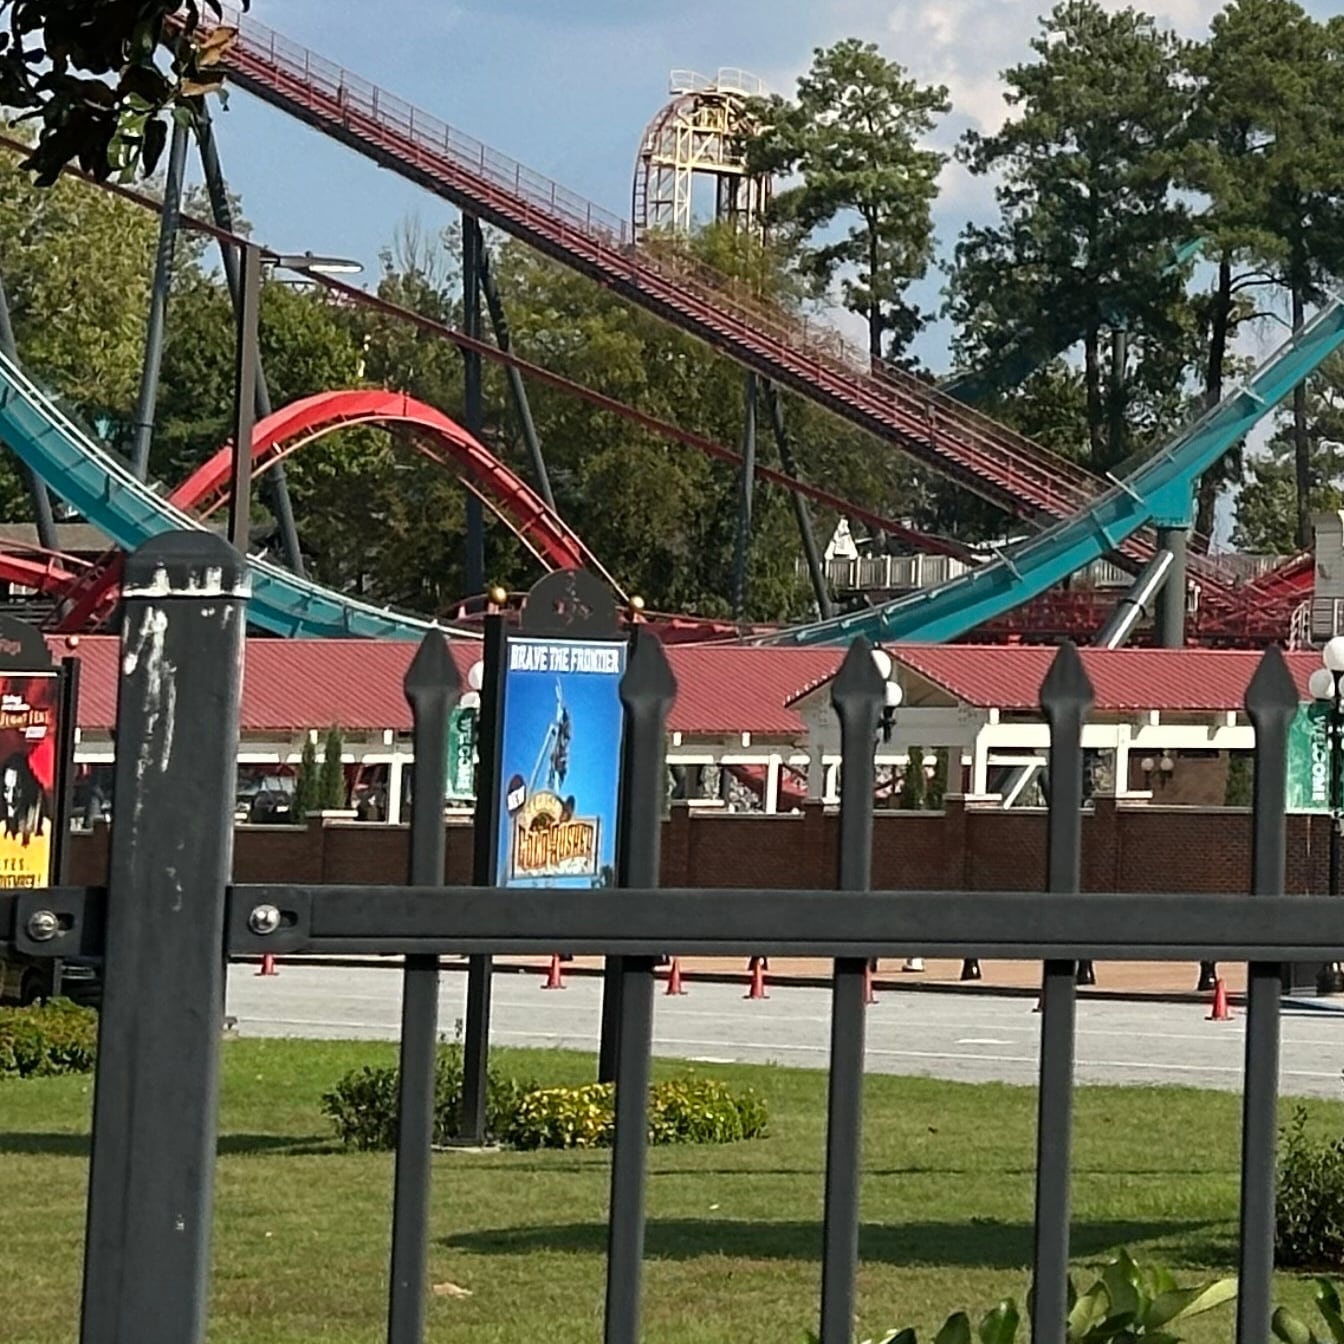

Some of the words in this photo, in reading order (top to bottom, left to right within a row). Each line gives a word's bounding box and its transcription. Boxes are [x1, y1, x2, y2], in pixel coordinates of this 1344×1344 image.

[510, 644, 548, 671] BRAVE
[549, 645, 570, 672] THE
[571, 647, 619, 673] FRONTIER
[1311, 715, 1326, 801] WELCOME
